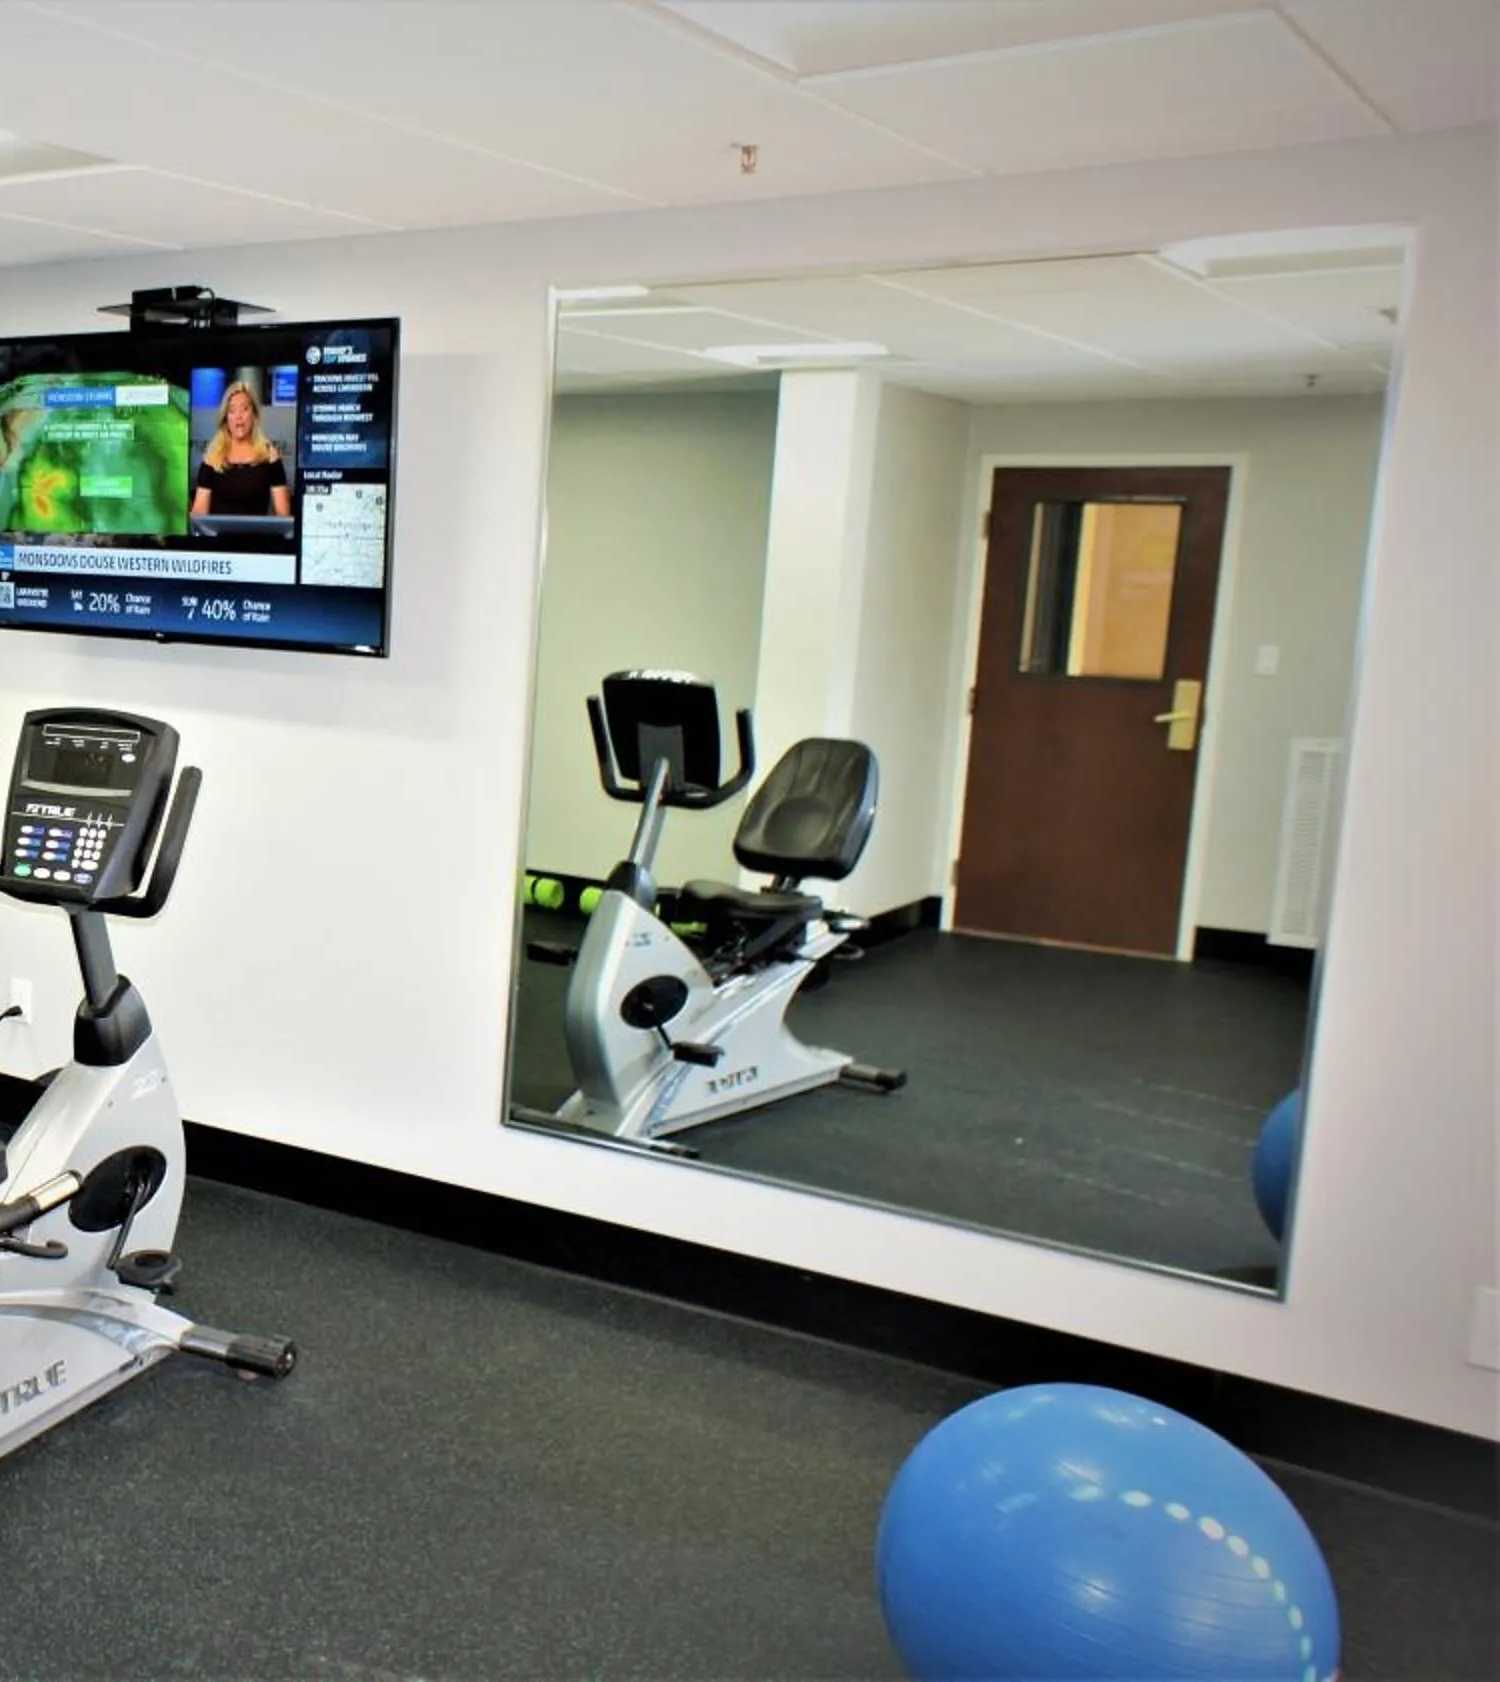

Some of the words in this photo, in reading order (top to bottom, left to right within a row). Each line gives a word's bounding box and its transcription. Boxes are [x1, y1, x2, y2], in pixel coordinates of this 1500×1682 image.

[19, 552, 77, 568] MONSOONS
[80, 555, 115, 569] DOUSE
[117, 556, 169, 573] WESTERN
[171, 558, 232, 575] WILDFIRES
[88, 591, 121, 613] 20%
[201, 599, 237, 621] 40%
